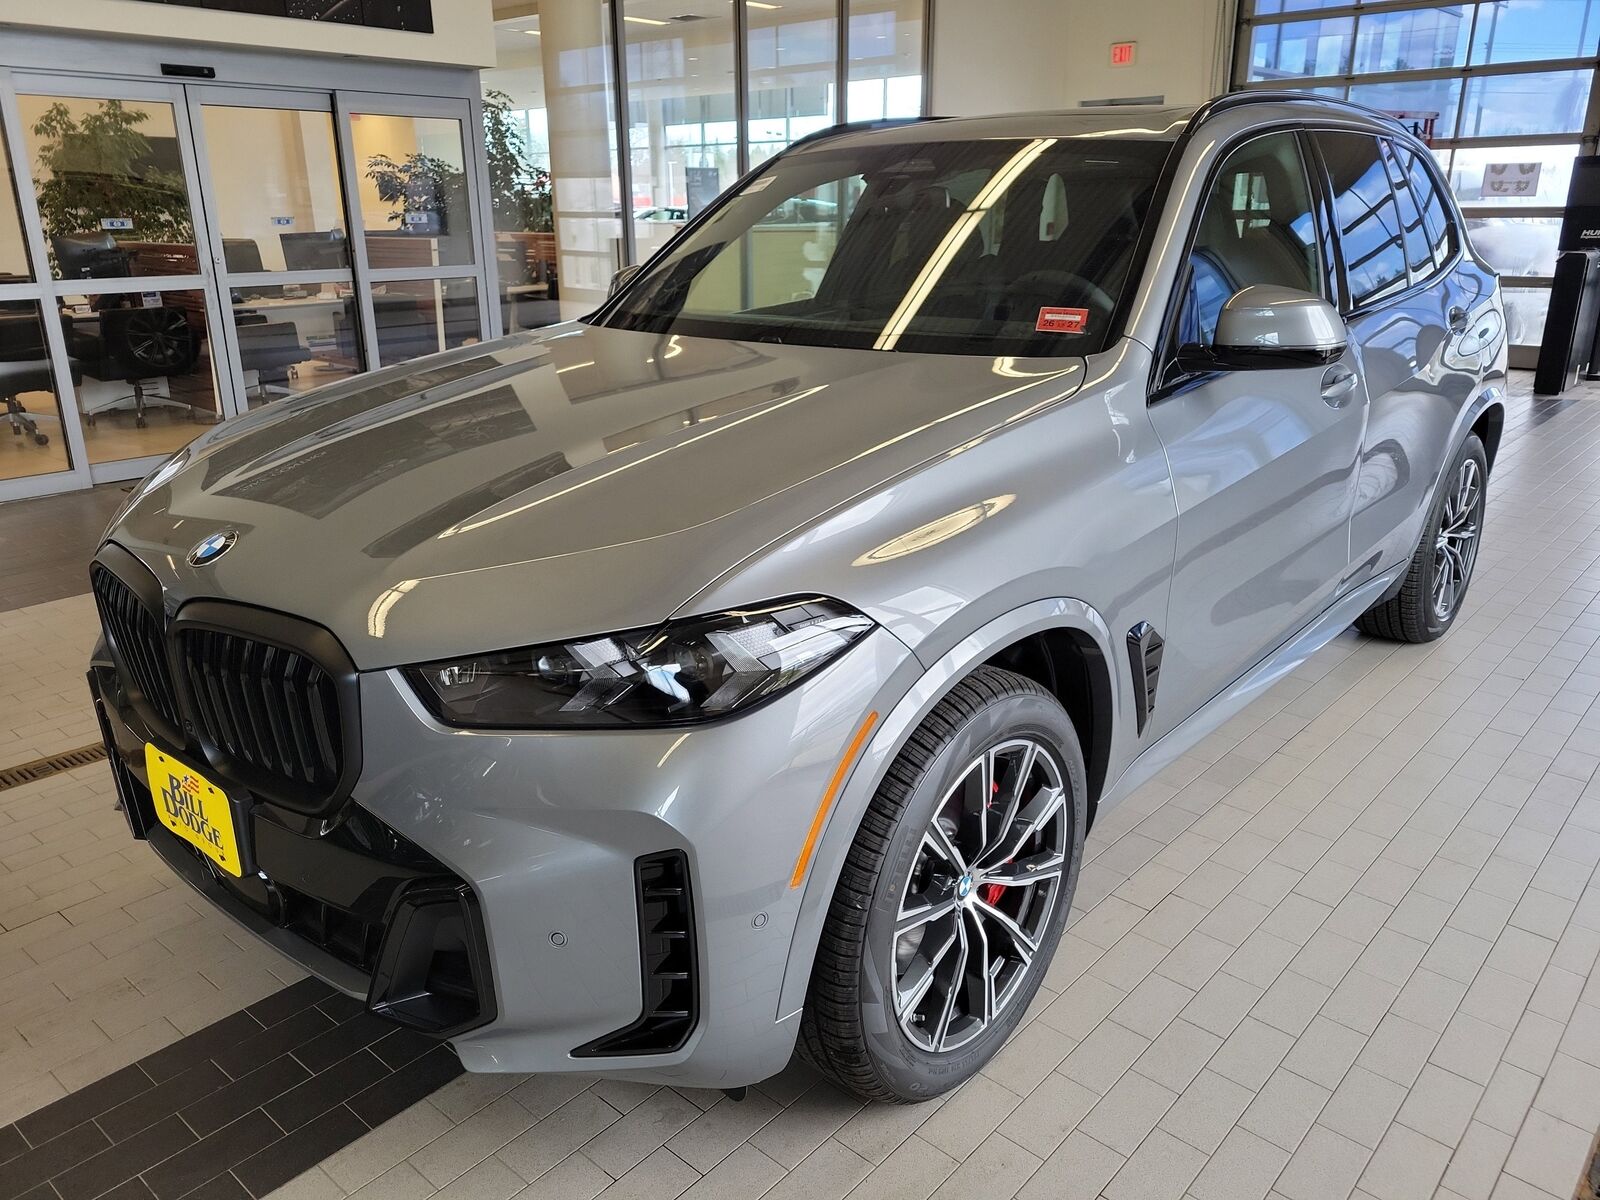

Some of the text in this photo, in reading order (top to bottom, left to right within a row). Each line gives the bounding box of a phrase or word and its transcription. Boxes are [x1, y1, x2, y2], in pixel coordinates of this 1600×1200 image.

[1043, 319, 1055, 327] 26
[1066, 320, 1080, 328] 27
[161, 787, 224, 850] DODGE
[167, 773, 208, 822] BILL
